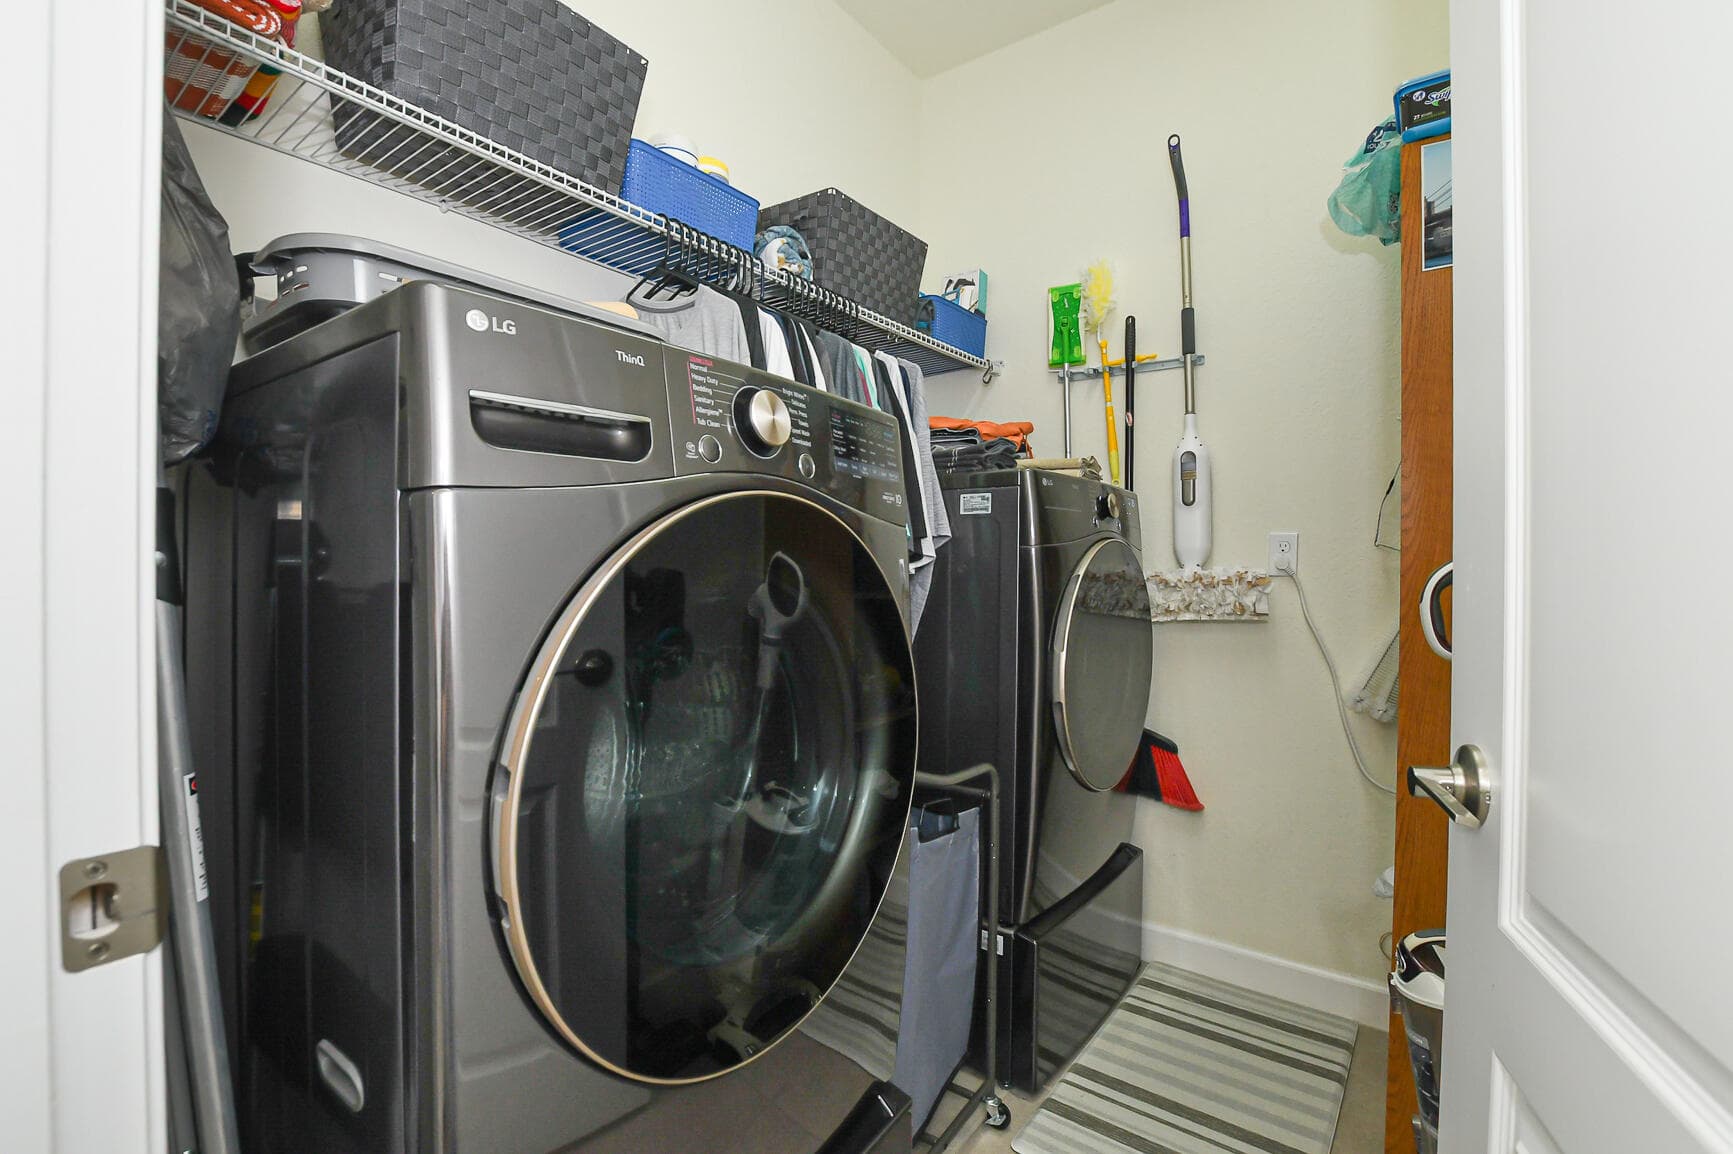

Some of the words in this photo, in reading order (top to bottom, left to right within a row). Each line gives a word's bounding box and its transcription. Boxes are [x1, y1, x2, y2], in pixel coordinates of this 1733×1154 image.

[492, 316, 517, 335] LG
[615, 349, 646, 367] ThinQ
[689, 362, 708, 373] Normal
[690, 372, 706, 383] Heavy
[706, 376, 719, 386] Duty
[692, 383, 713, 395] Bedding
[706, 419, 721, 428] Clean
